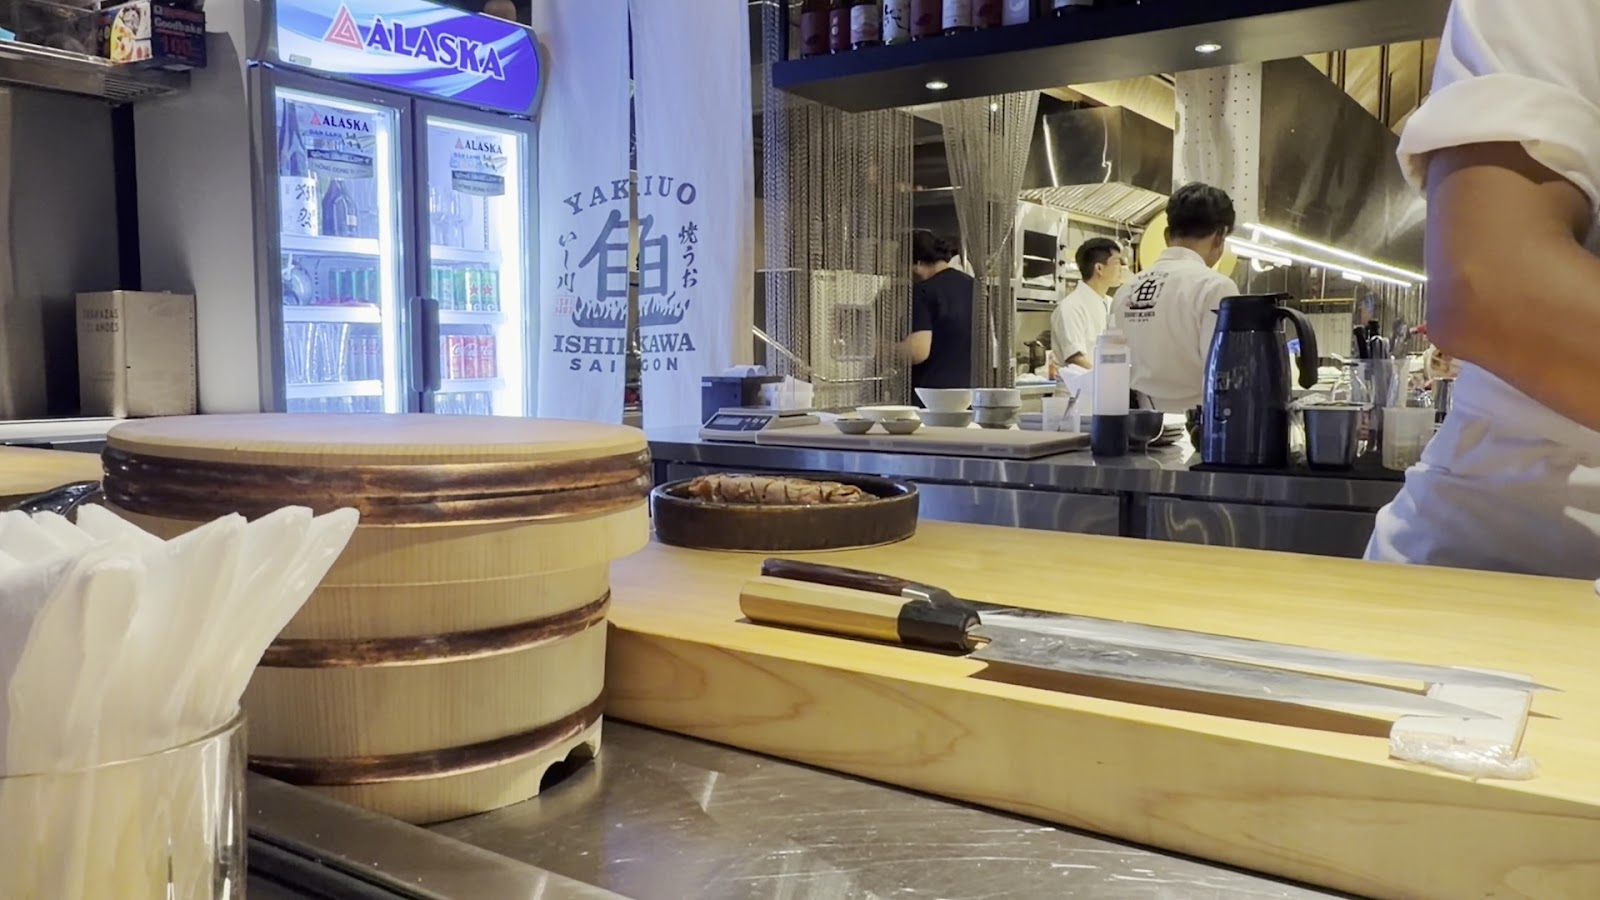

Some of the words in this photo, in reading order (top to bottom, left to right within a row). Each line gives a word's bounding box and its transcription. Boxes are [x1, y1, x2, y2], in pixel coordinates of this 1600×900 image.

[367, 17, 504, 79] ALASKA
[322, 115, 369, 132] ALASKA
[465, 139, 503, 155] ALASKA
[569, 357, 678, 373] SAIGON
